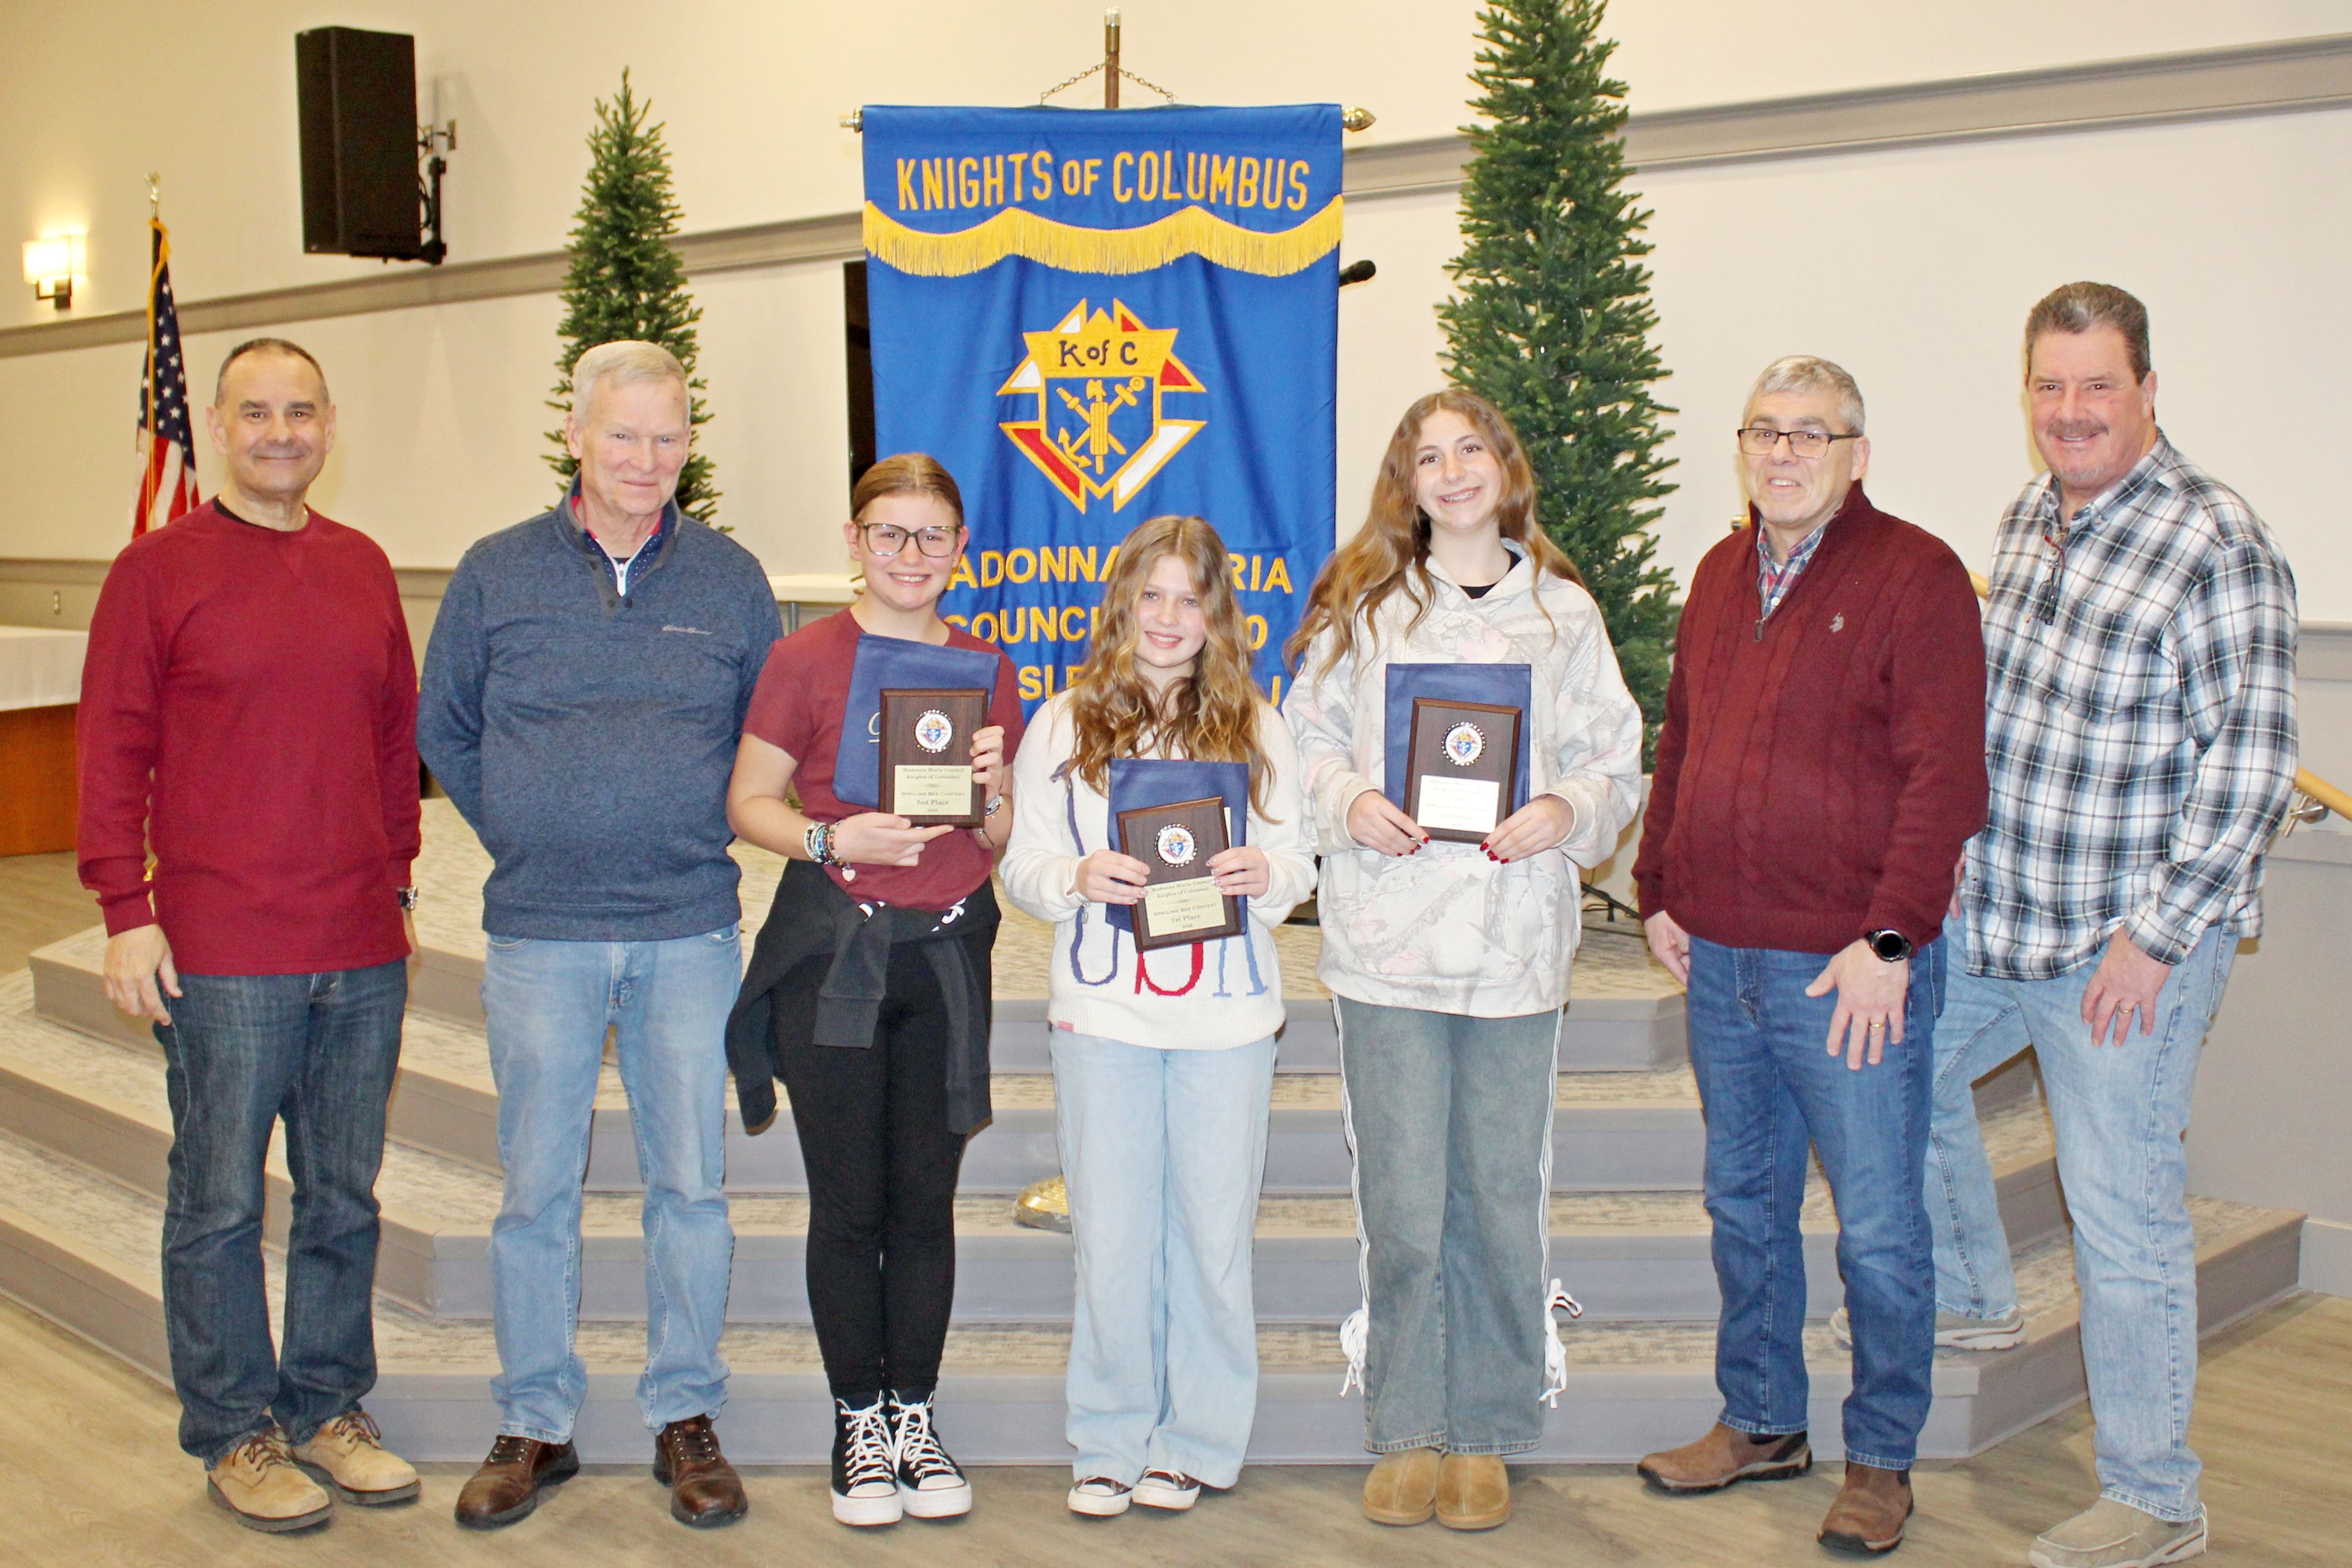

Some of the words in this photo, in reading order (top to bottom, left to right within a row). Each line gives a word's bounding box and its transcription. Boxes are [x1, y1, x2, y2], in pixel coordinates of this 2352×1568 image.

[897, 150, 1052, 211] KNIGHTS
[1062, 158, 1102, 196] OF
[1112, 150, 1310, 211] COLUMBUS
[1059, 340, 1085, 367] K
[1087, 339, 1110, 366] of
[1120, 341, 1137, 365] C
[1227, 553, 1294, 594] RIA
